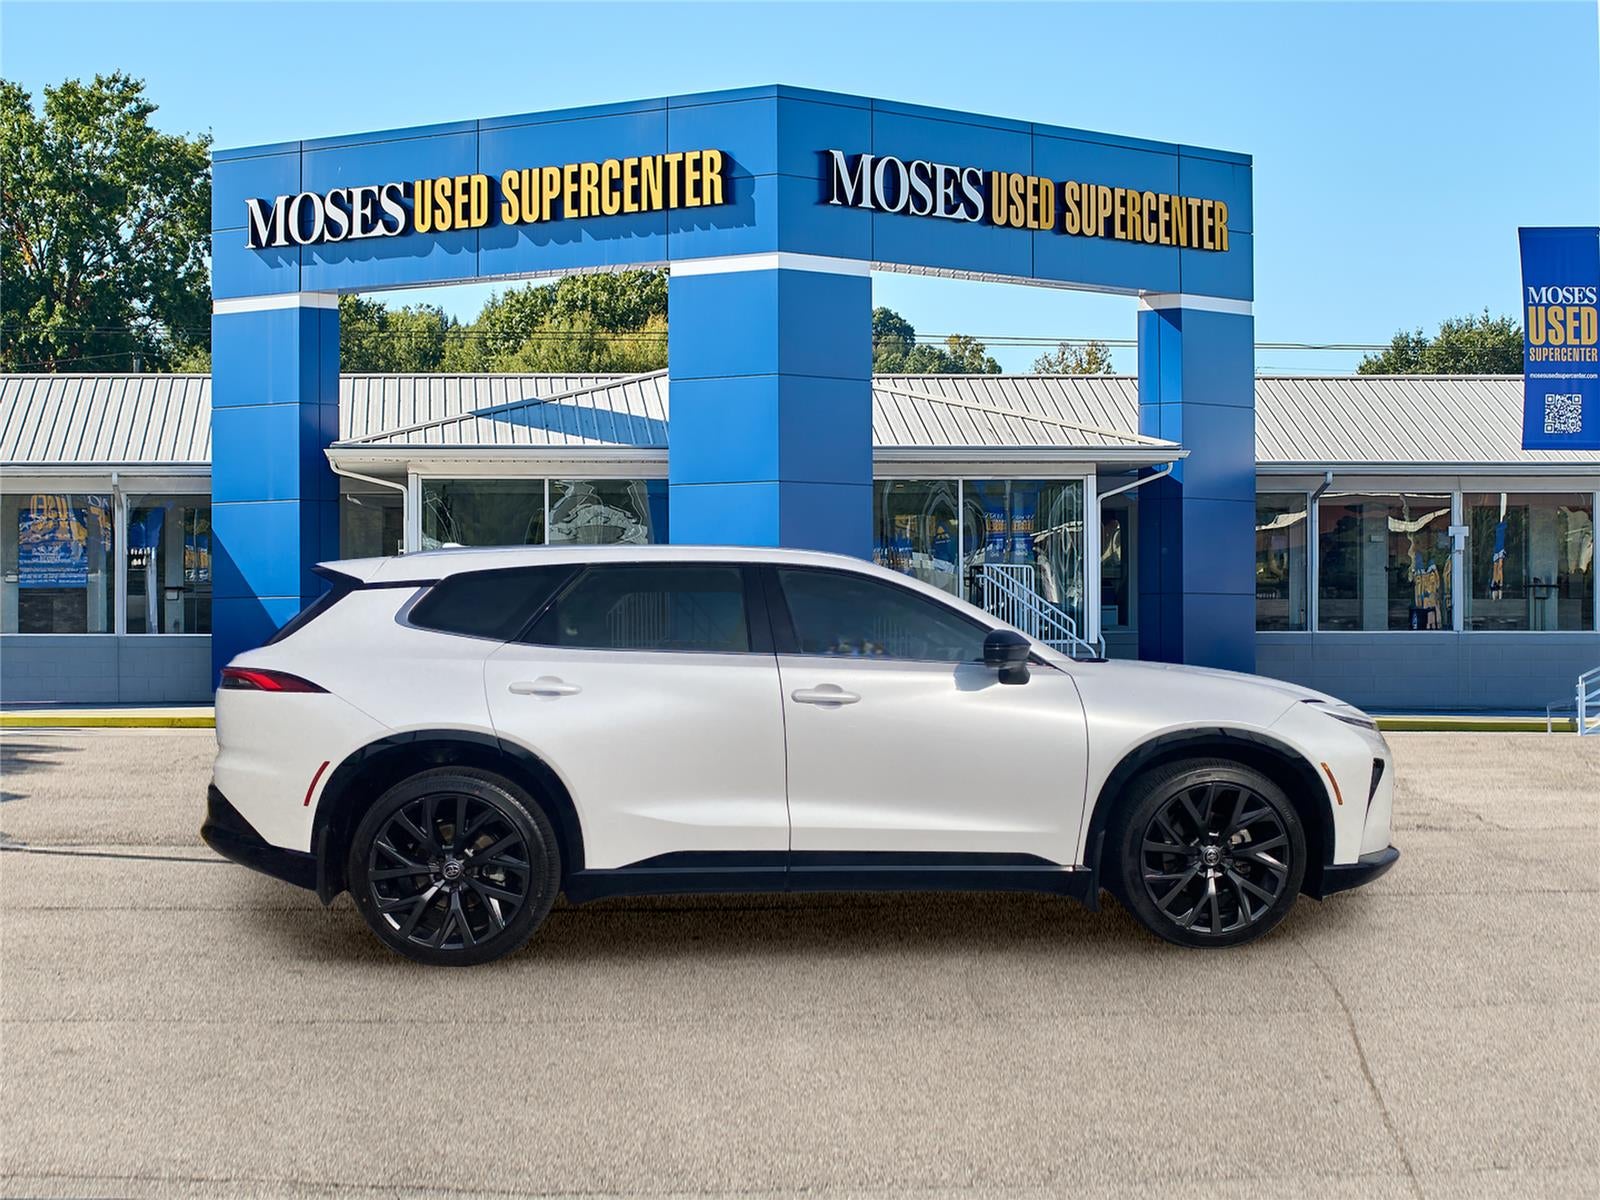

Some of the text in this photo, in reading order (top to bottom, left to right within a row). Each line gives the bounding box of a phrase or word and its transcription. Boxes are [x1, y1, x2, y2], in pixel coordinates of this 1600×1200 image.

[244, 148, 724, 250] MOSES USED SUPERCENTER
[828, 149, 1230, 252] MOSES USED SUPERCENTER
[1527, 286, 1597, 305] MOSES
[1528, 306, 1598, 346] USED
[1529, 347, 1598, 362] SUPERCENTER
